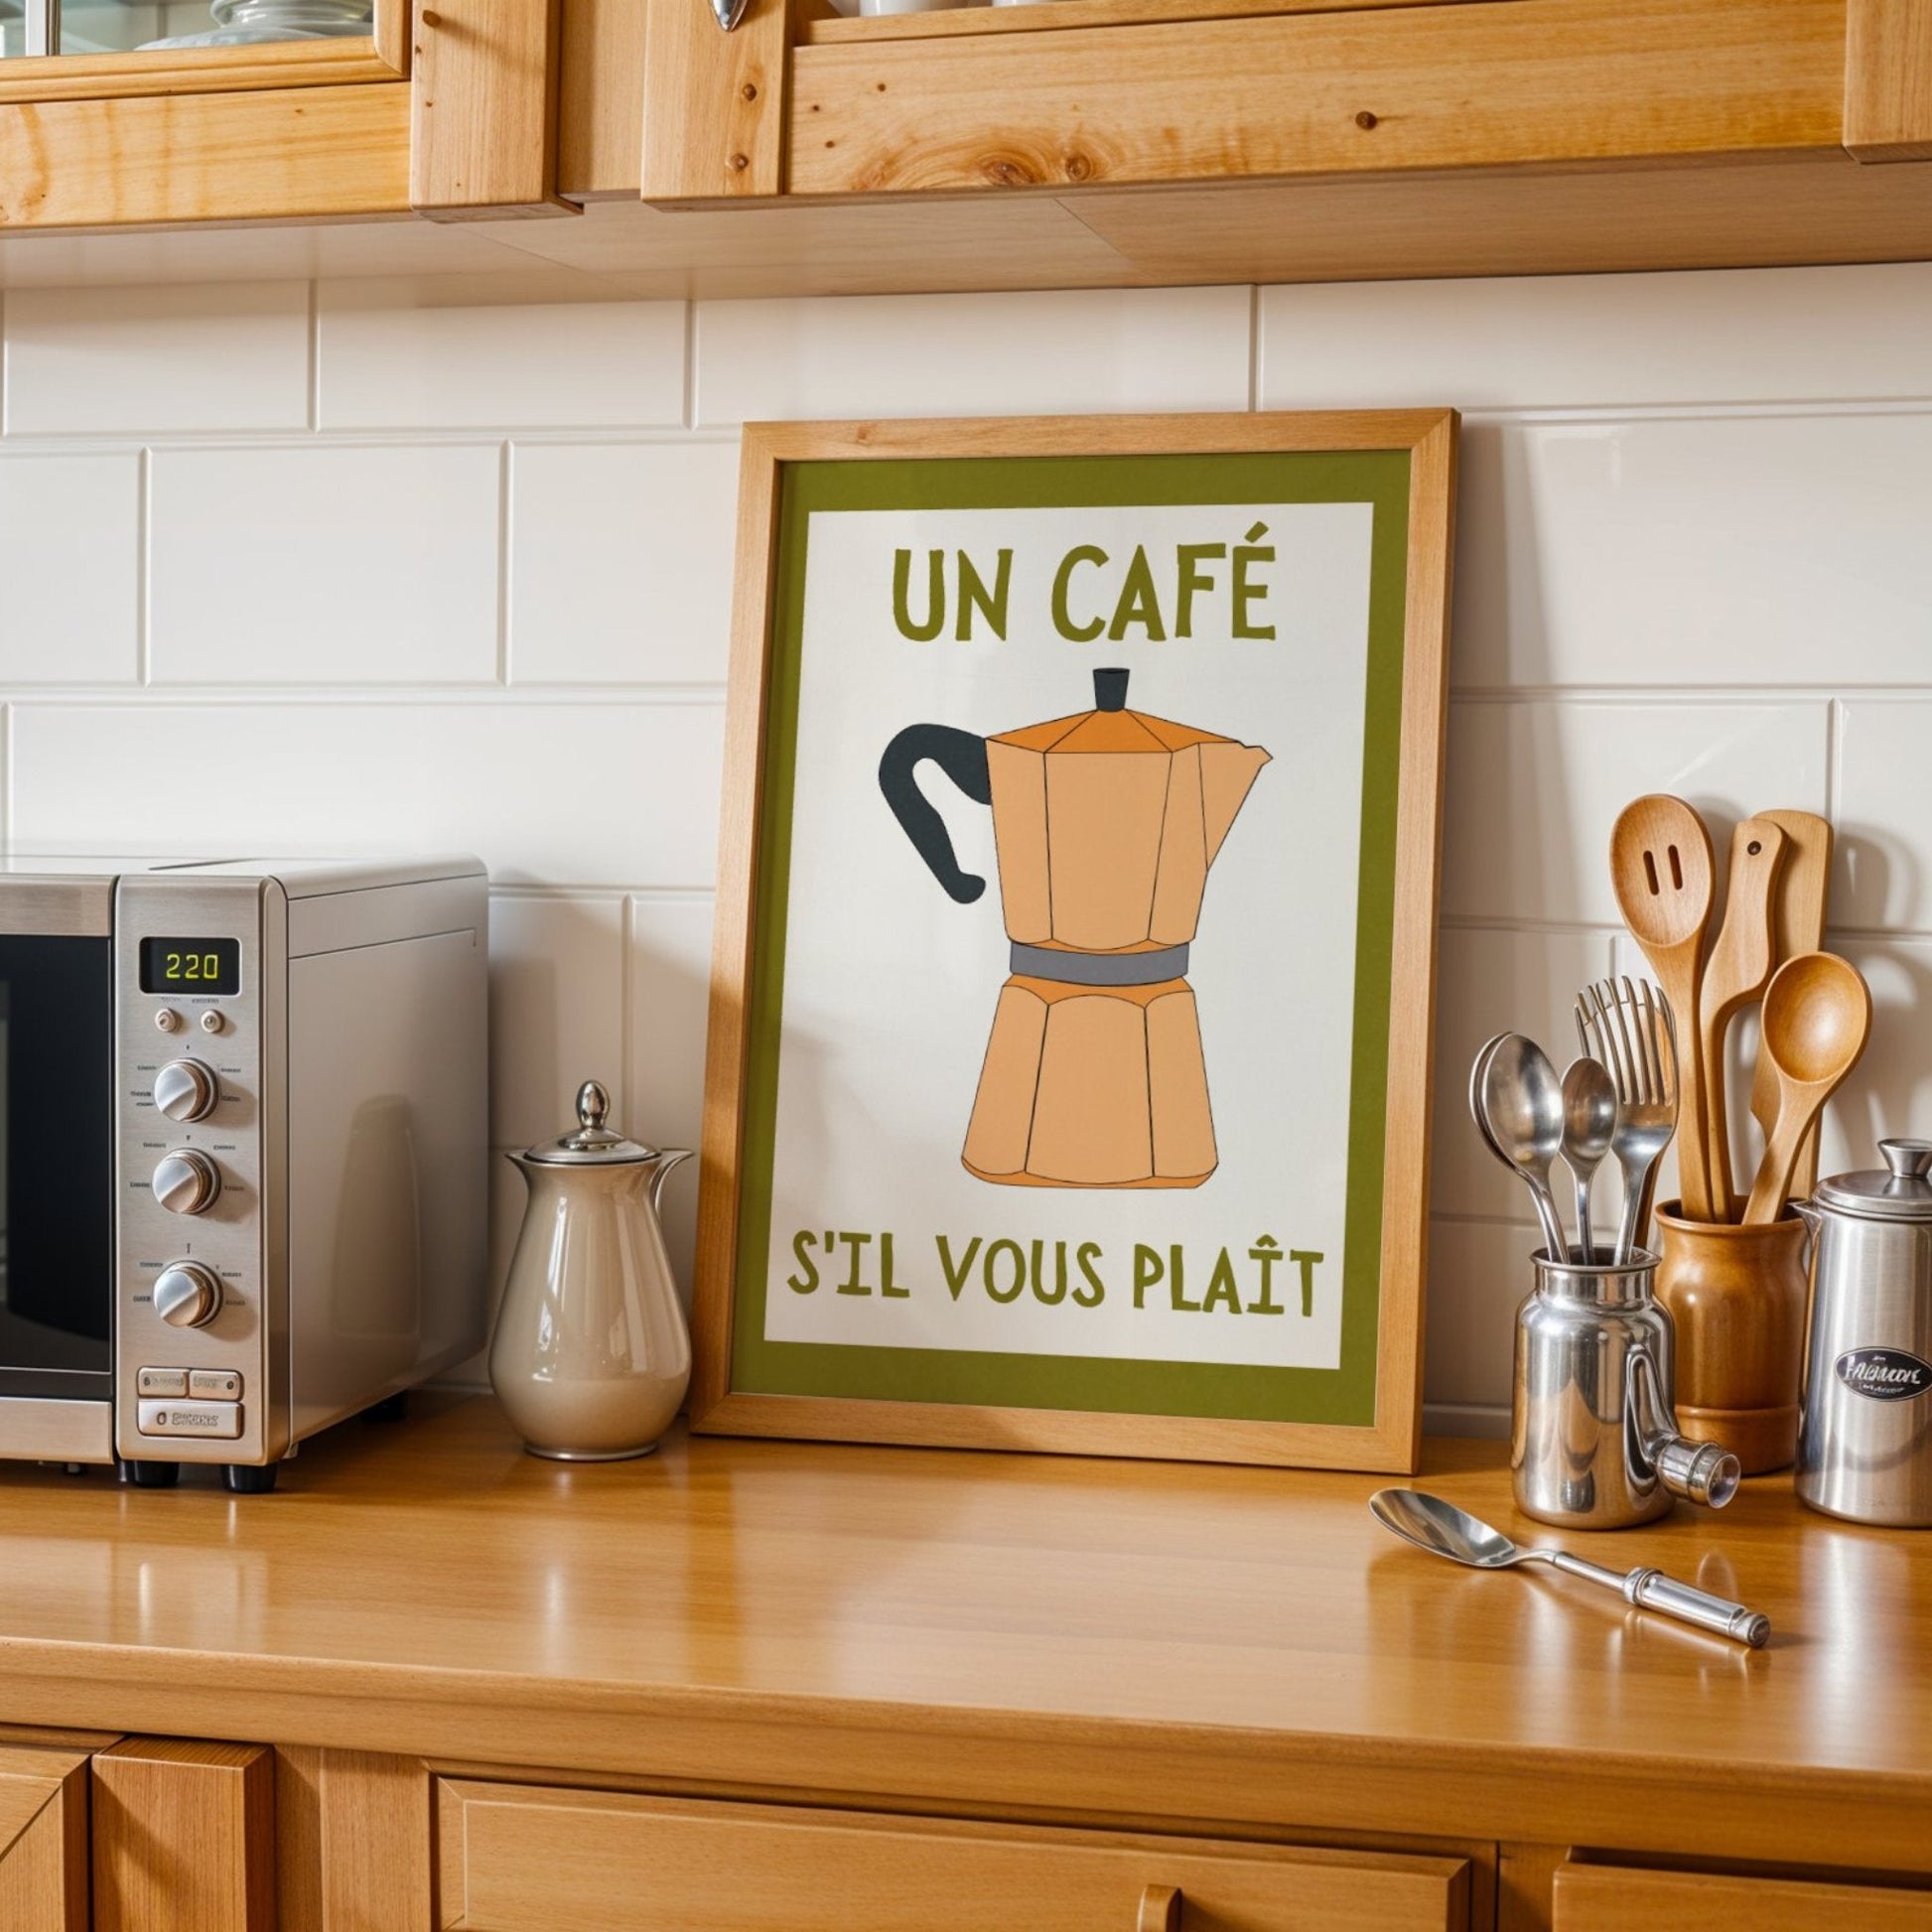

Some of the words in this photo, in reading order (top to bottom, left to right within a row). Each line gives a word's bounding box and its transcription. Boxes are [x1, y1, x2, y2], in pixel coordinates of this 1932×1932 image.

[893, 548, 1014, 642] UN
[1050, 521, 1277, 643] CAFÉ
[165, 953, 219, 980] 220
[787, 1230, 910, 1299] S'IL
[935, 1234, 1105, 1309] VOUS
[1133, 1234, 1324, 1317] PLAÎT
